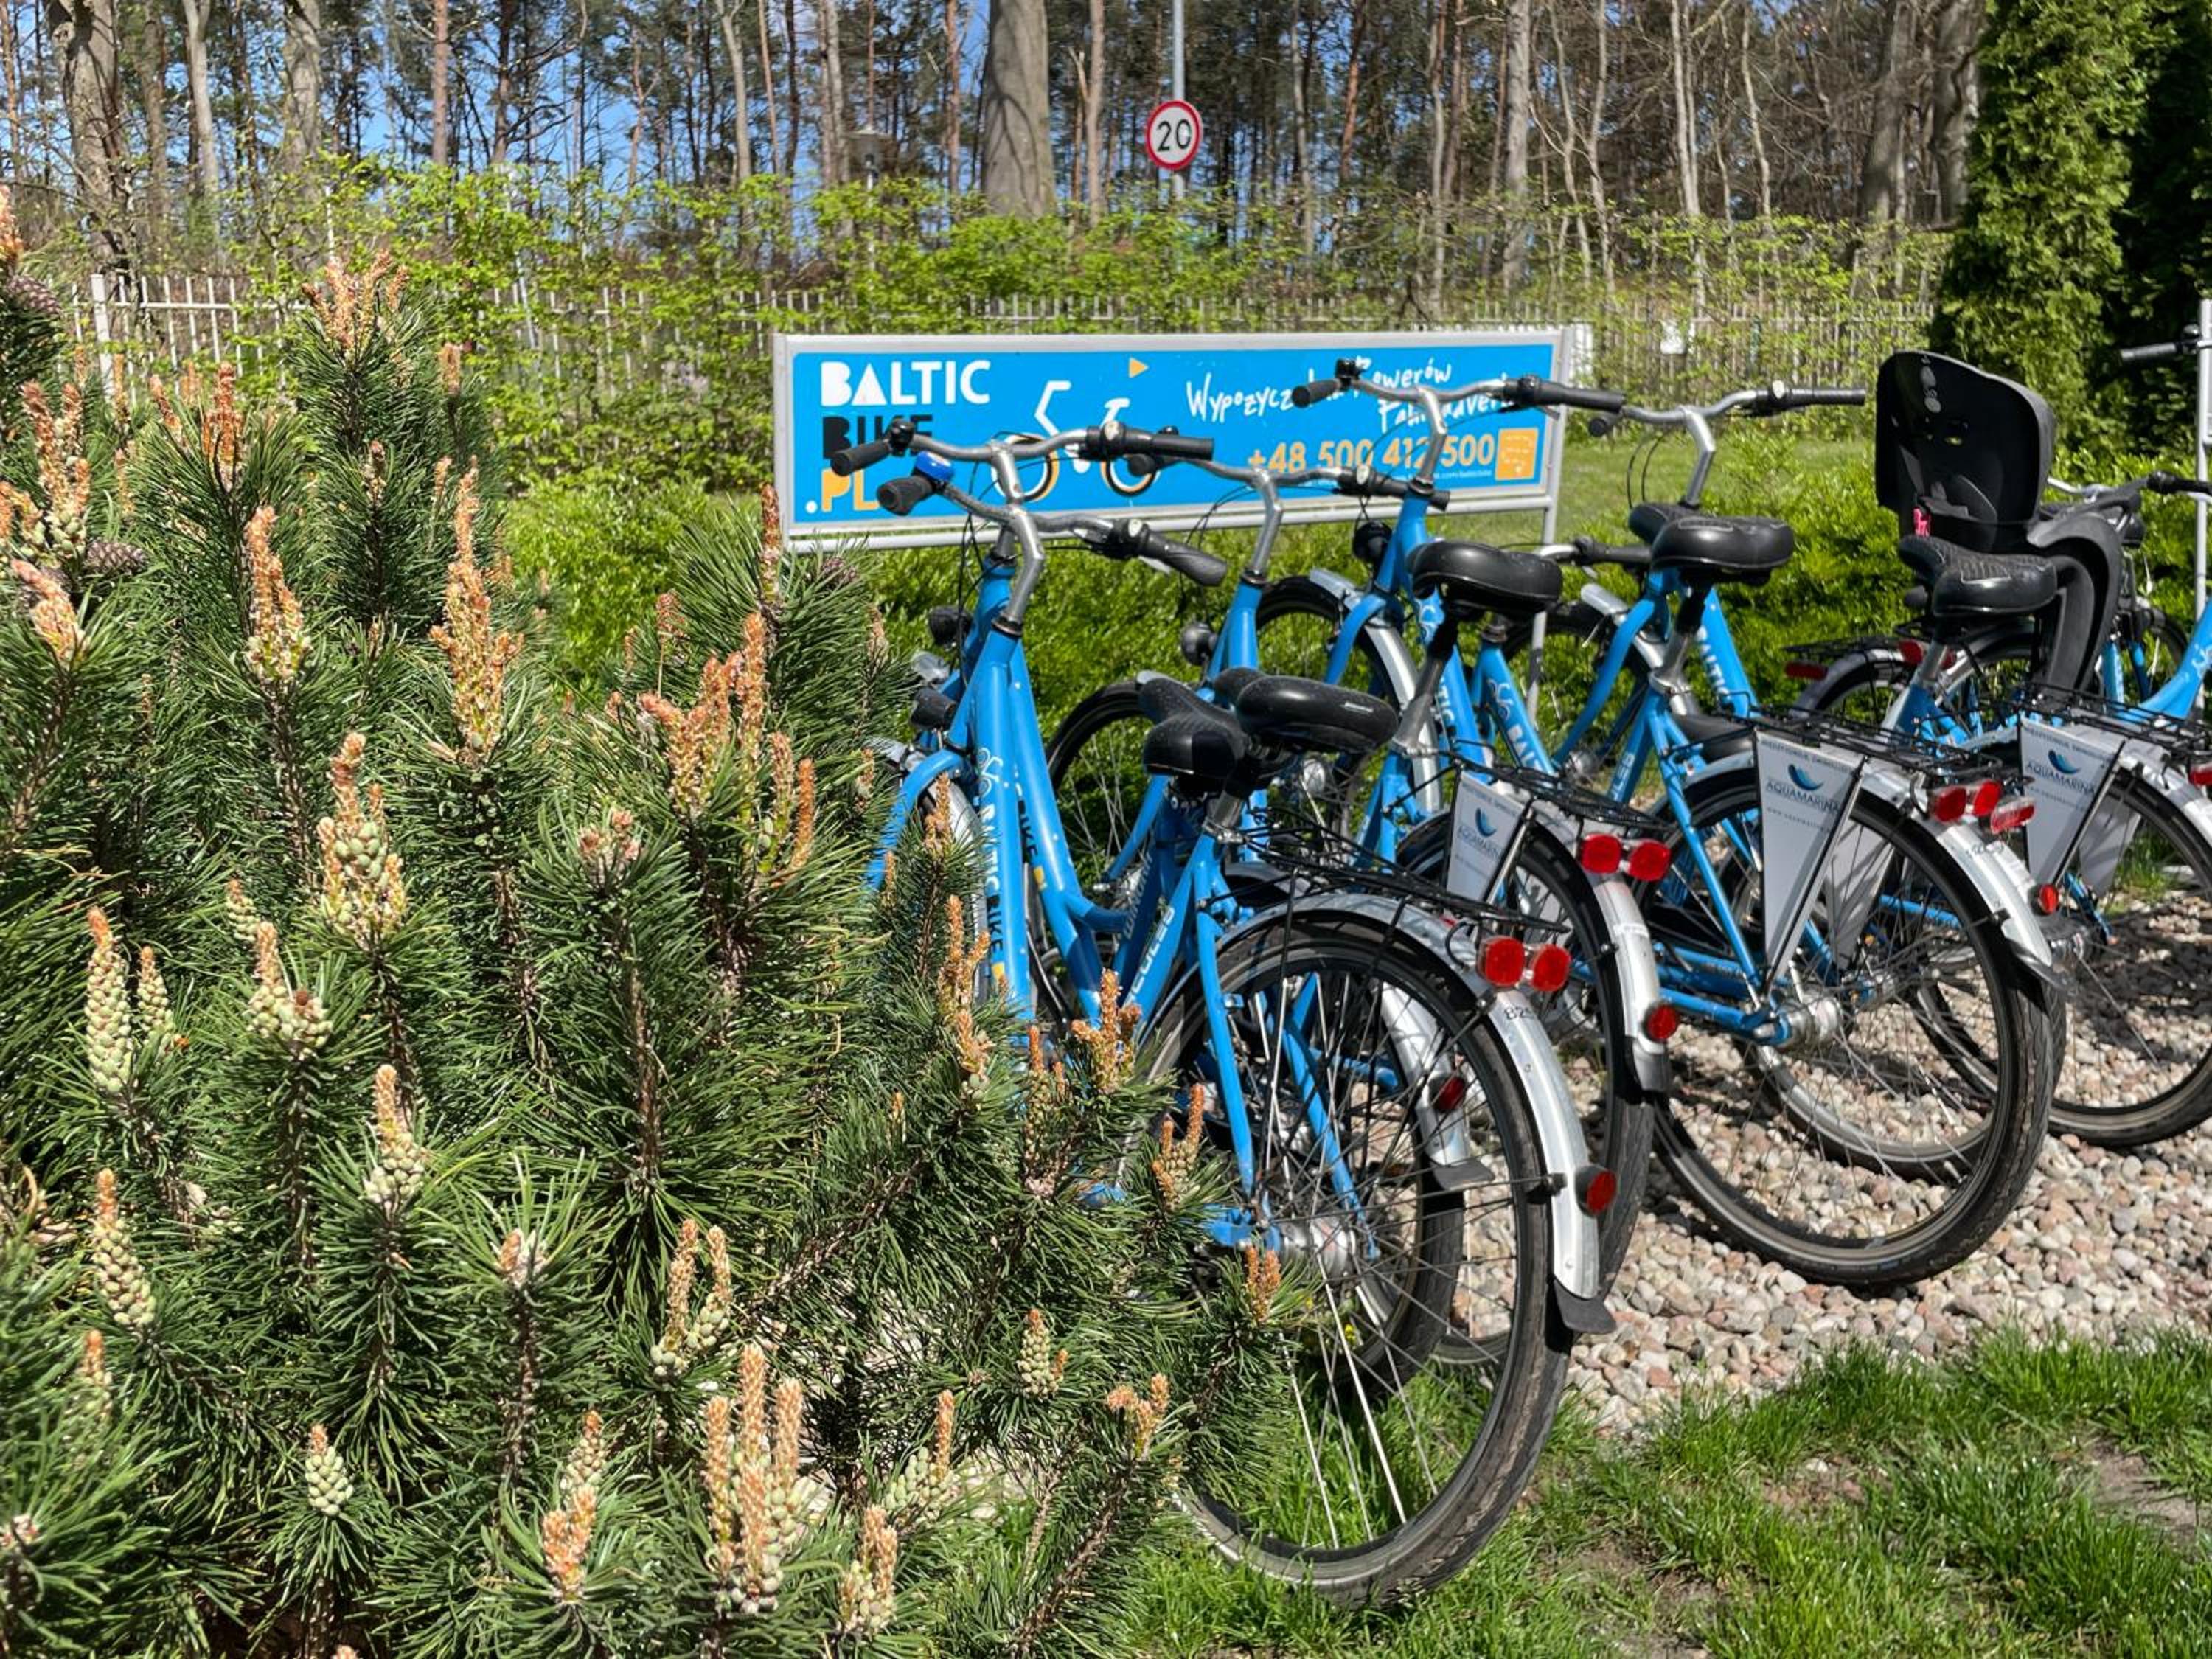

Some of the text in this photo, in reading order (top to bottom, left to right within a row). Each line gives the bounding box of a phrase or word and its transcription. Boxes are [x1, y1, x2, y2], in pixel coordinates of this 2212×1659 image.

[1157, 119, 1192, 152] 20
[821, 360, 991, 407] BALTIC
[1248, 441, 1307, 473] +48
[1318, 439, 1374, 472] 500
[1439, 433, 1495, 468] 500
